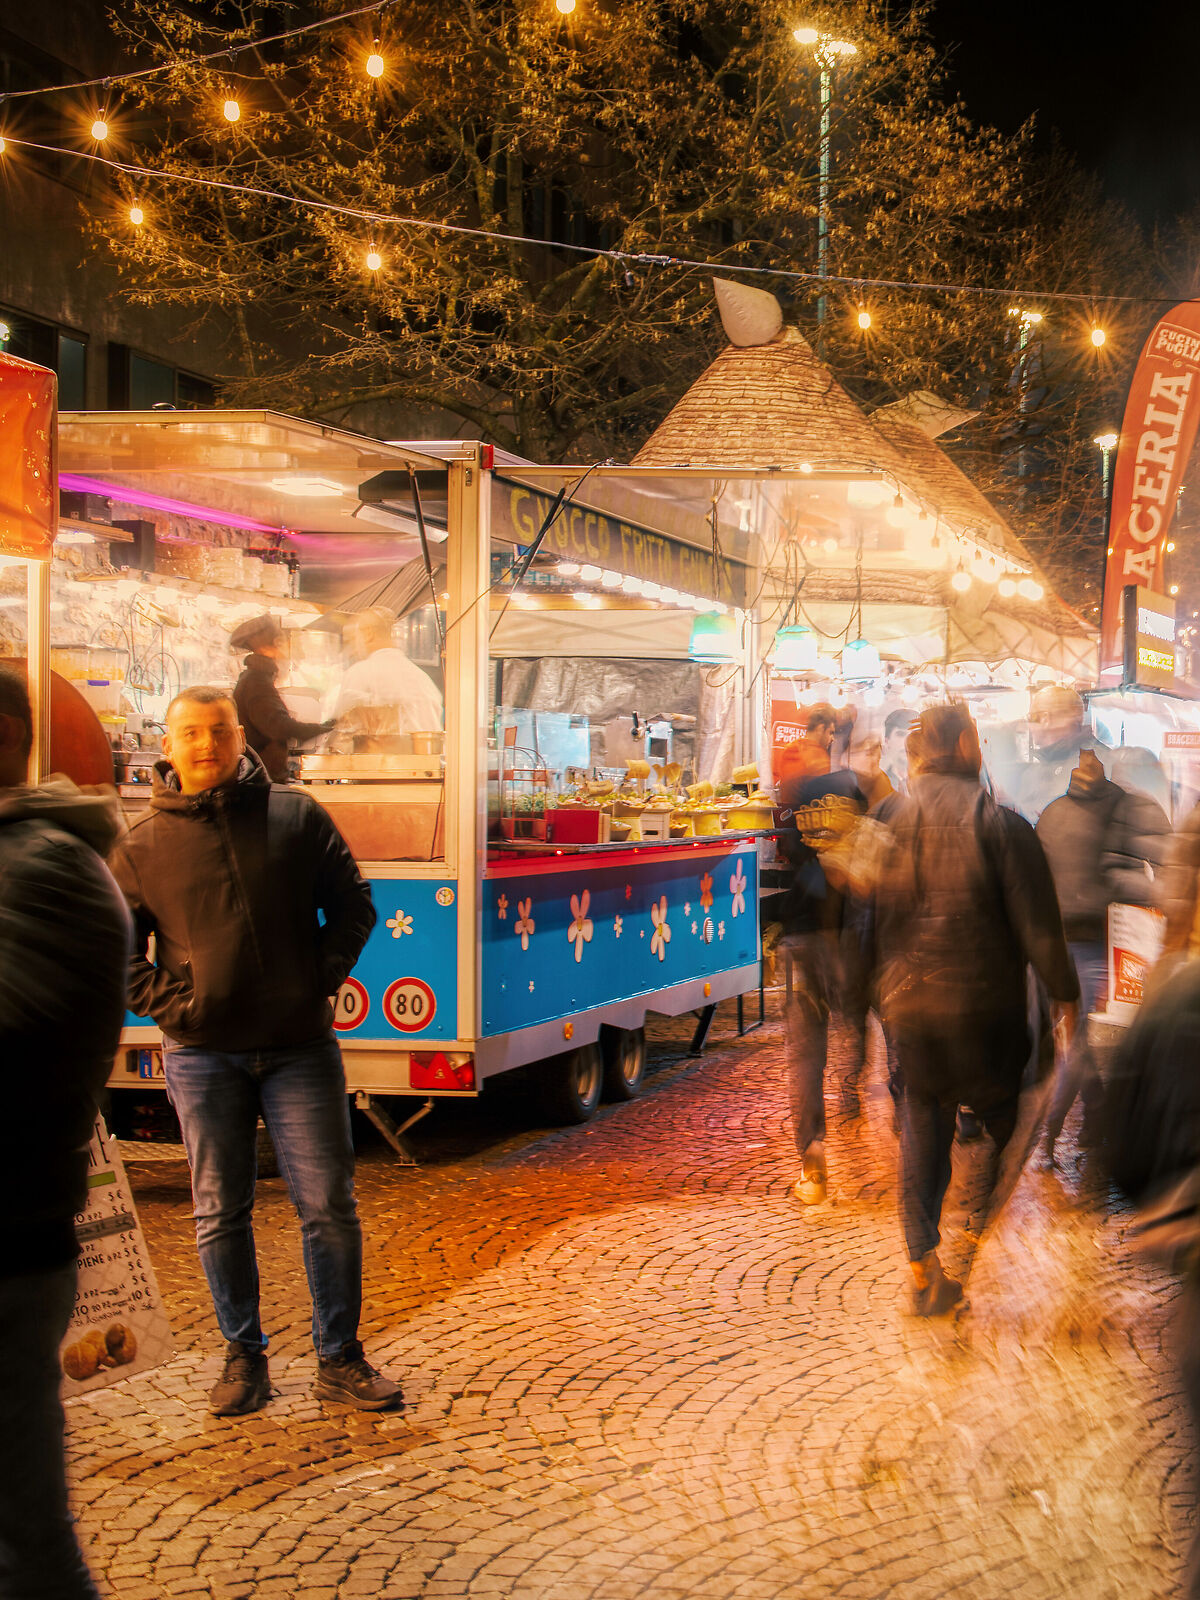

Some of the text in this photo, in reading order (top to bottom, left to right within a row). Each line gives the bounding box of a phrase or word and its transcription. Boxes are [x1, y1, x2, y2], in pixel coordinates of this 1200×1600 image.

[510, 487, 610, 559] GNOCCO
[776, 726, 808, 737] CUCIN
[396, 993, 424, 1016] 80
[77, 1253, 105, 1270] PIENE
[131, 1290, 142, 1300] 10
